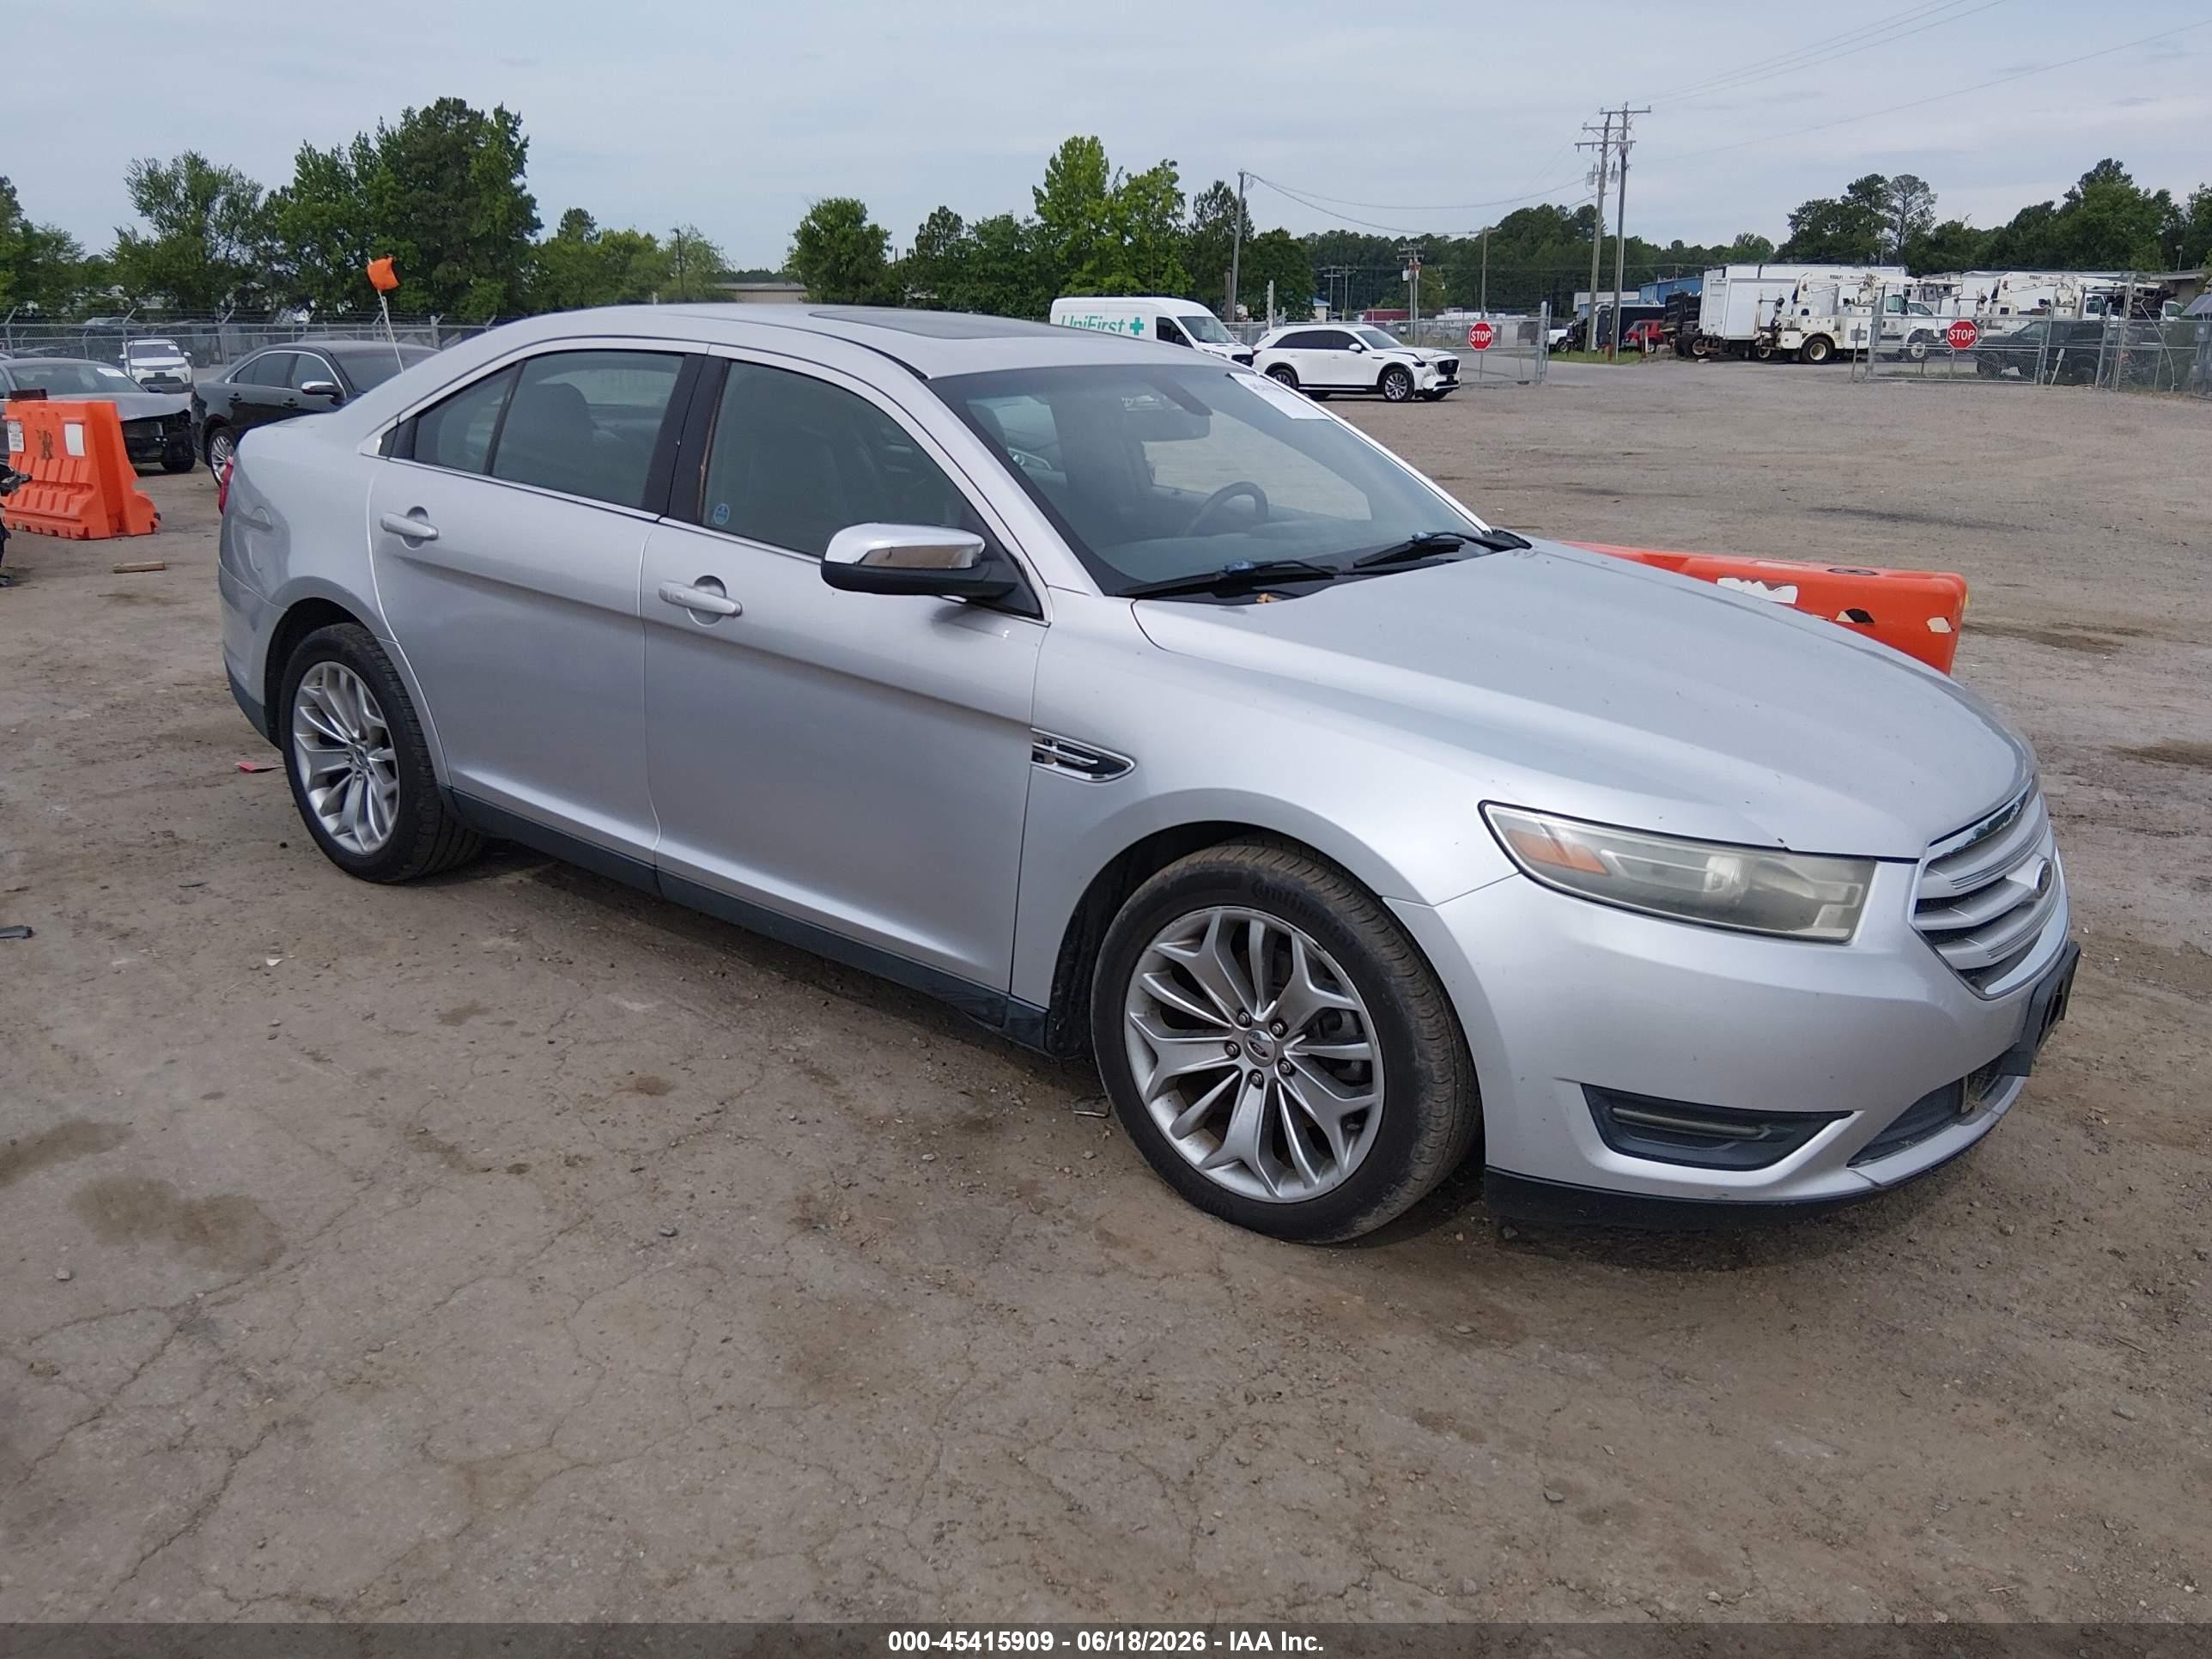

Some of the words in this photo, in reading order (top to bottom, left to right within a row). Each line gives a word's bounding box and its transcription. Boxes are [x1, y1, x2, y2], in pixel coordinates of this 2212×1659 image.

[1061, 315, 1126, 332] UniFirst
[1470, 330, 1492, 343] STOP
[1949, 329, 1975, 341] STOP
